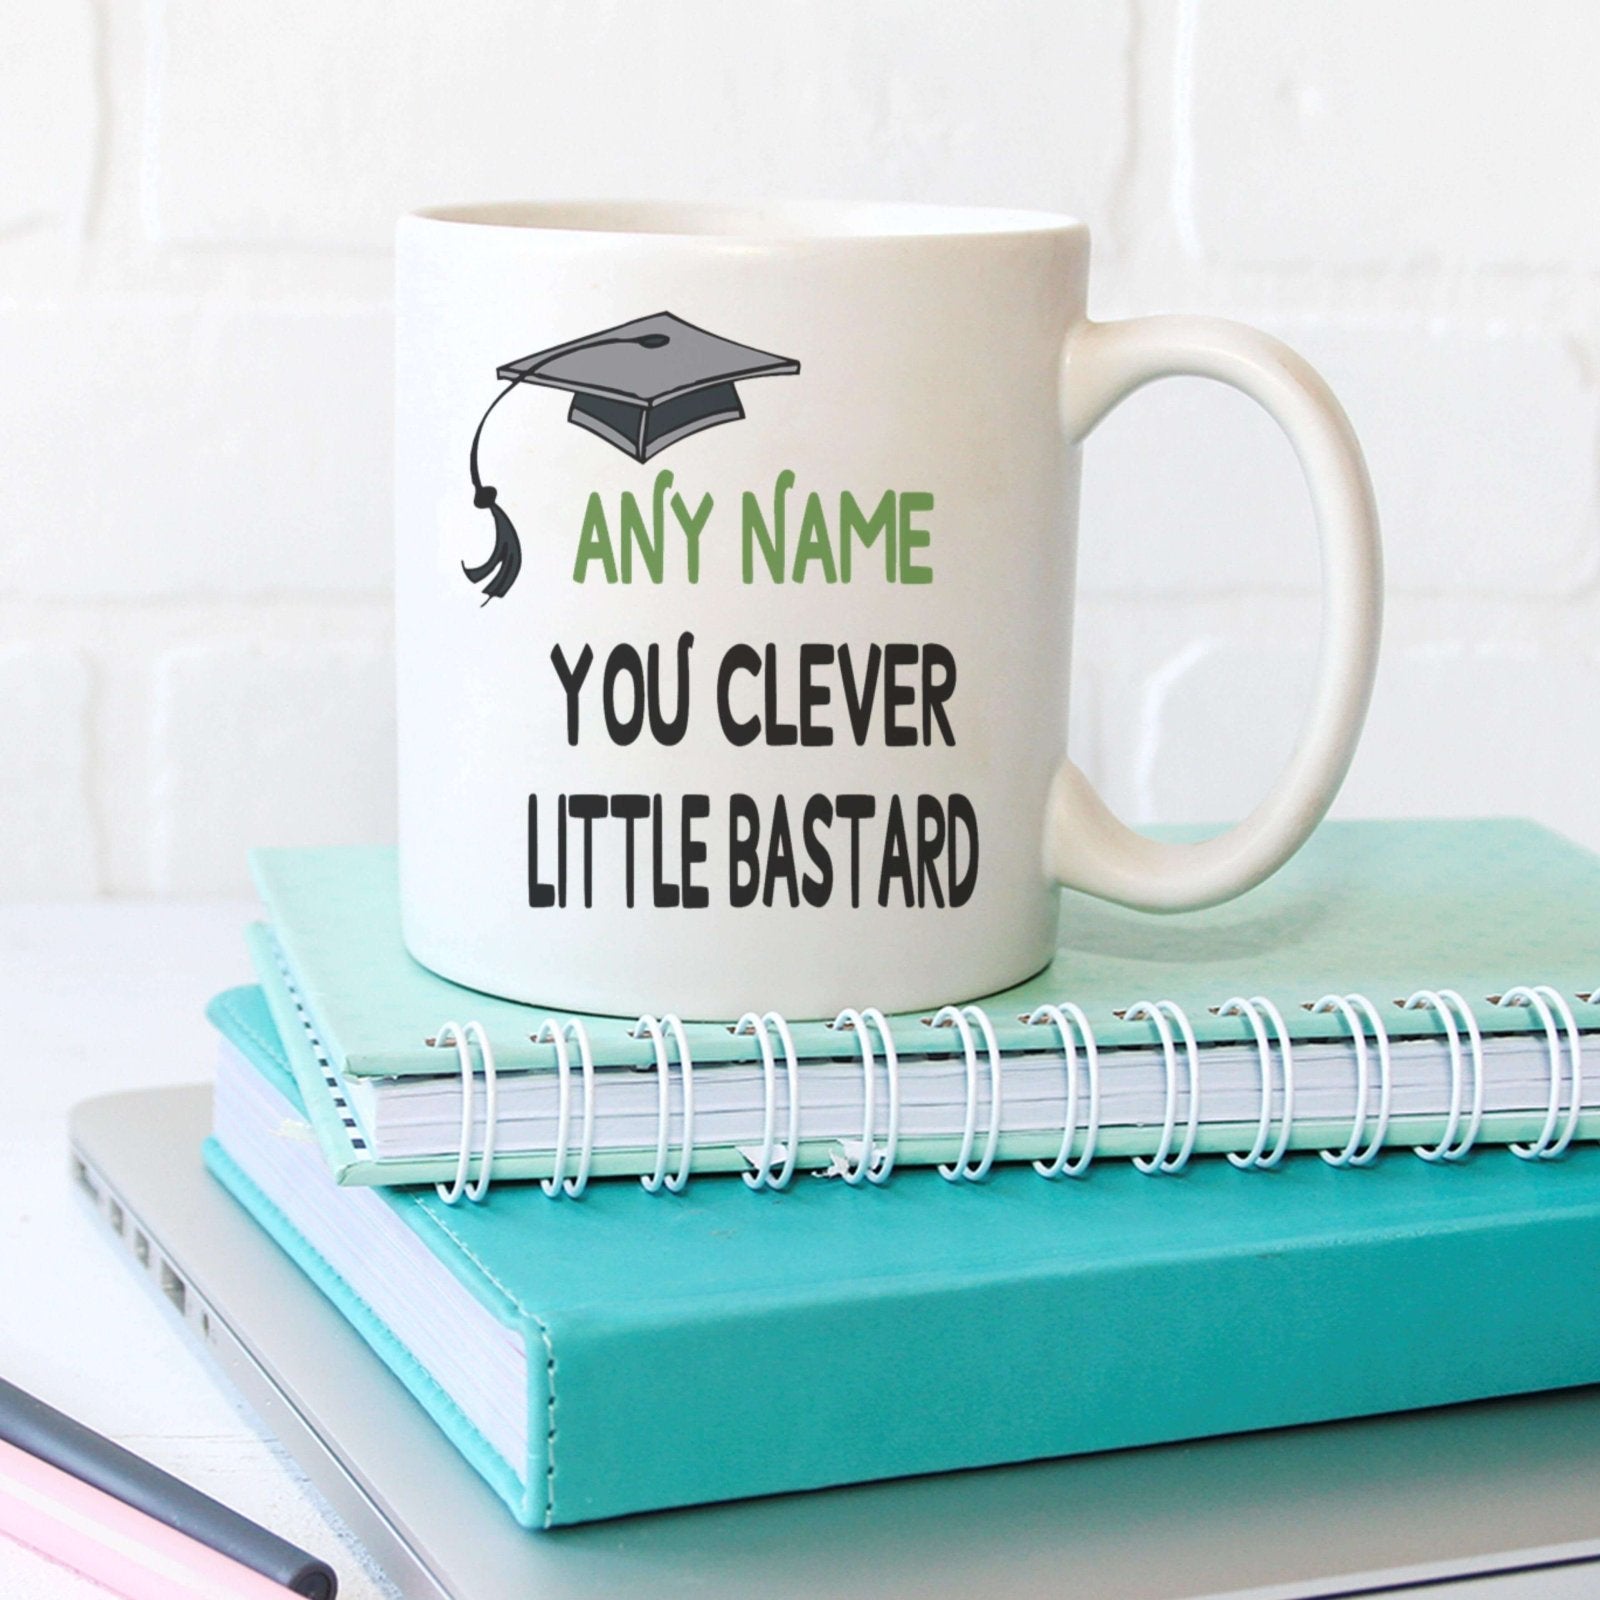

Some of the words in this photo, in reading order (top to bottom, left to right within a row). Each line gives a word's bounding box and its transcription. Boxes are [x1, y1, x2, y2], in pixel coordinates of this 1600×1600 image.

[573, 469, 714, 585] ANY
[742, 469, 935, 585] NAME
[551, 630, 695, 748] YOU
[717, 642, 958, 748] CLEVER
[528, 793, 710, 910] LITTLE
[729, 792, 980, 910] BASTARD
